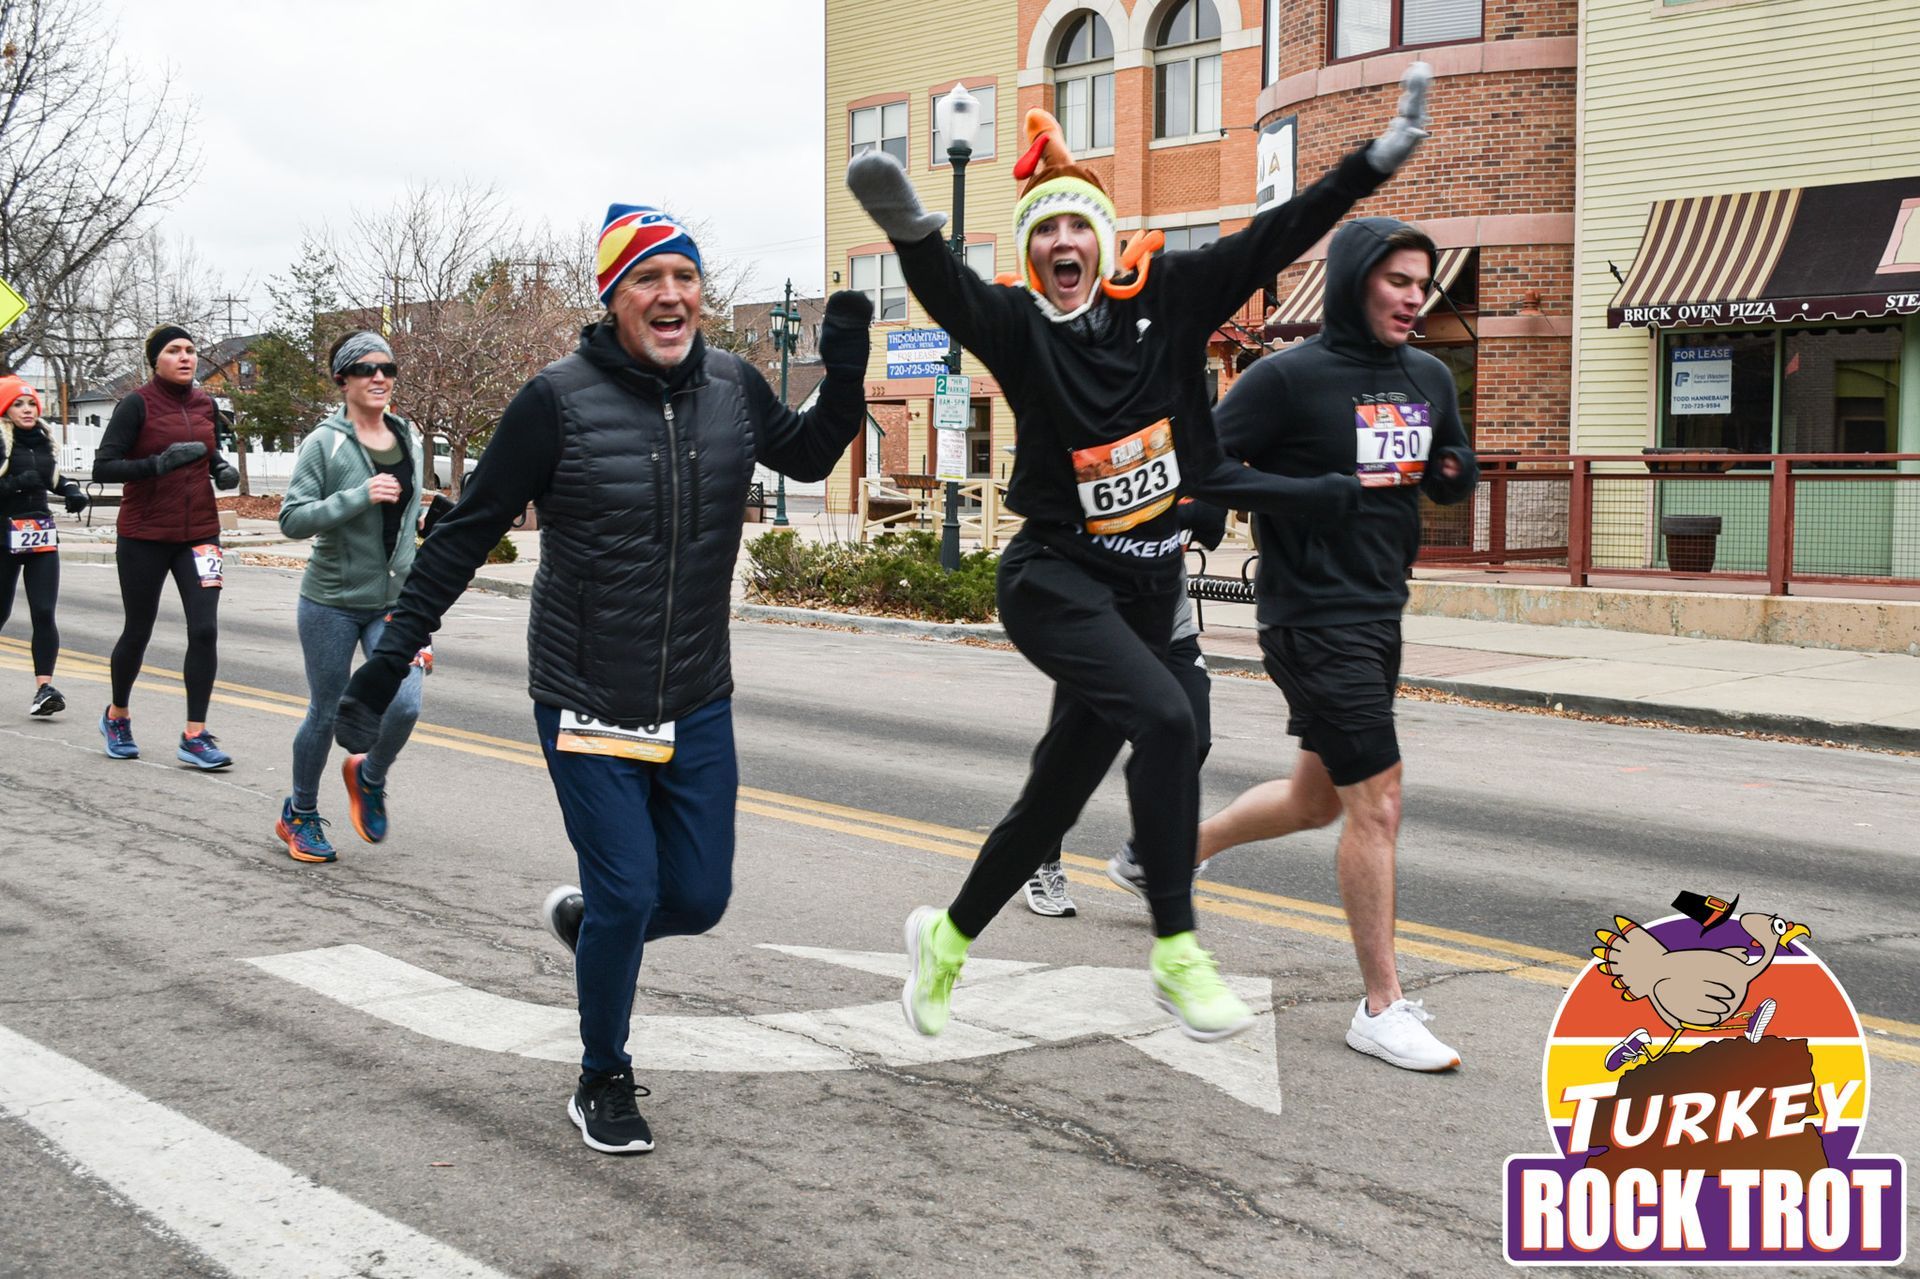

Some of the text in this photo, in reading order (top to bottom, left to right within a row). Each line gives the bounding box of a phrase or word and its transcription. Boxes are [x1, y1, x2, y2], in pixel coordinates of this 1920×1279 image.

[1885, 293, 1920, 308] STE
[1623, 302, 1776, 321] BRICK OVEN PIZZA
[897, 349, 938, 361] FOR LEASE
[1674, 348, 1730, 360] FOR LEASE
[889, 364, 945, 376] 720-725-9594
[937, 378, 946, 392] 2
[1374, 430, 1420, 459] 750
[1093, 461, 1168, 511] 6323
[21, 531, 49, 546] 224
[1092, 534, 1160, 558] NIKE
